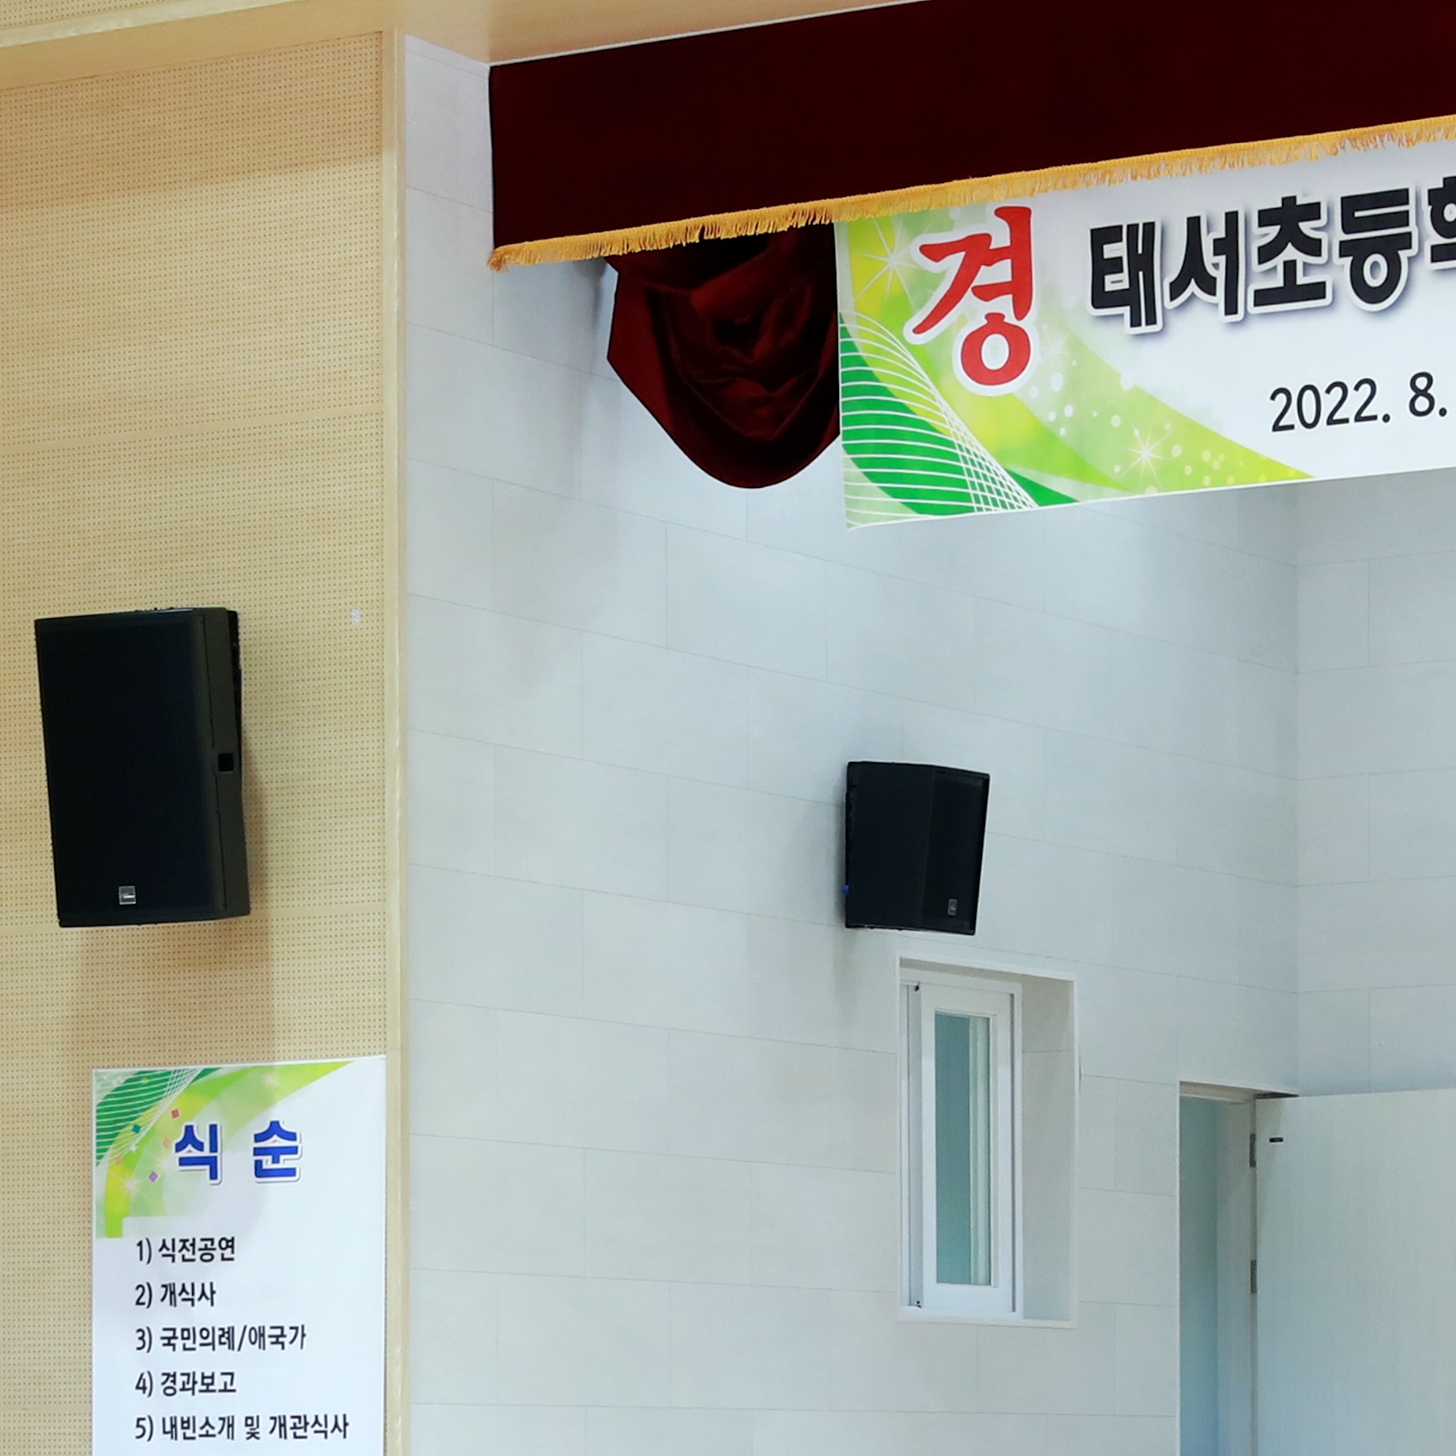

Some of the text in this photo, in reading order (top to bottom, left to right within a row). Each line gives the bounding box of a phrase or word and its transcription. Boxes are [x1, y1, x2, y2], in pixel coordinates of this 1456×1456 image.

[914, 206, 1033, 385] 경
[1271, 379, 1390, 431] 2022.
[1410, 372, 1446, 416] 8.
[175, 1120, 300, 1181] 식 순
[136, 1236, 235, 1265] 1) 식전공연
[135, 1281, 216, 1309] 2) 개식사
[136, 1324, 306, 1353] 3) 국민의례/애국가
[135, 1370, 237, 1397] 4) 경과보고
[135, 1413, 349, 1442] 5) 내빈소개 및 개관식사
